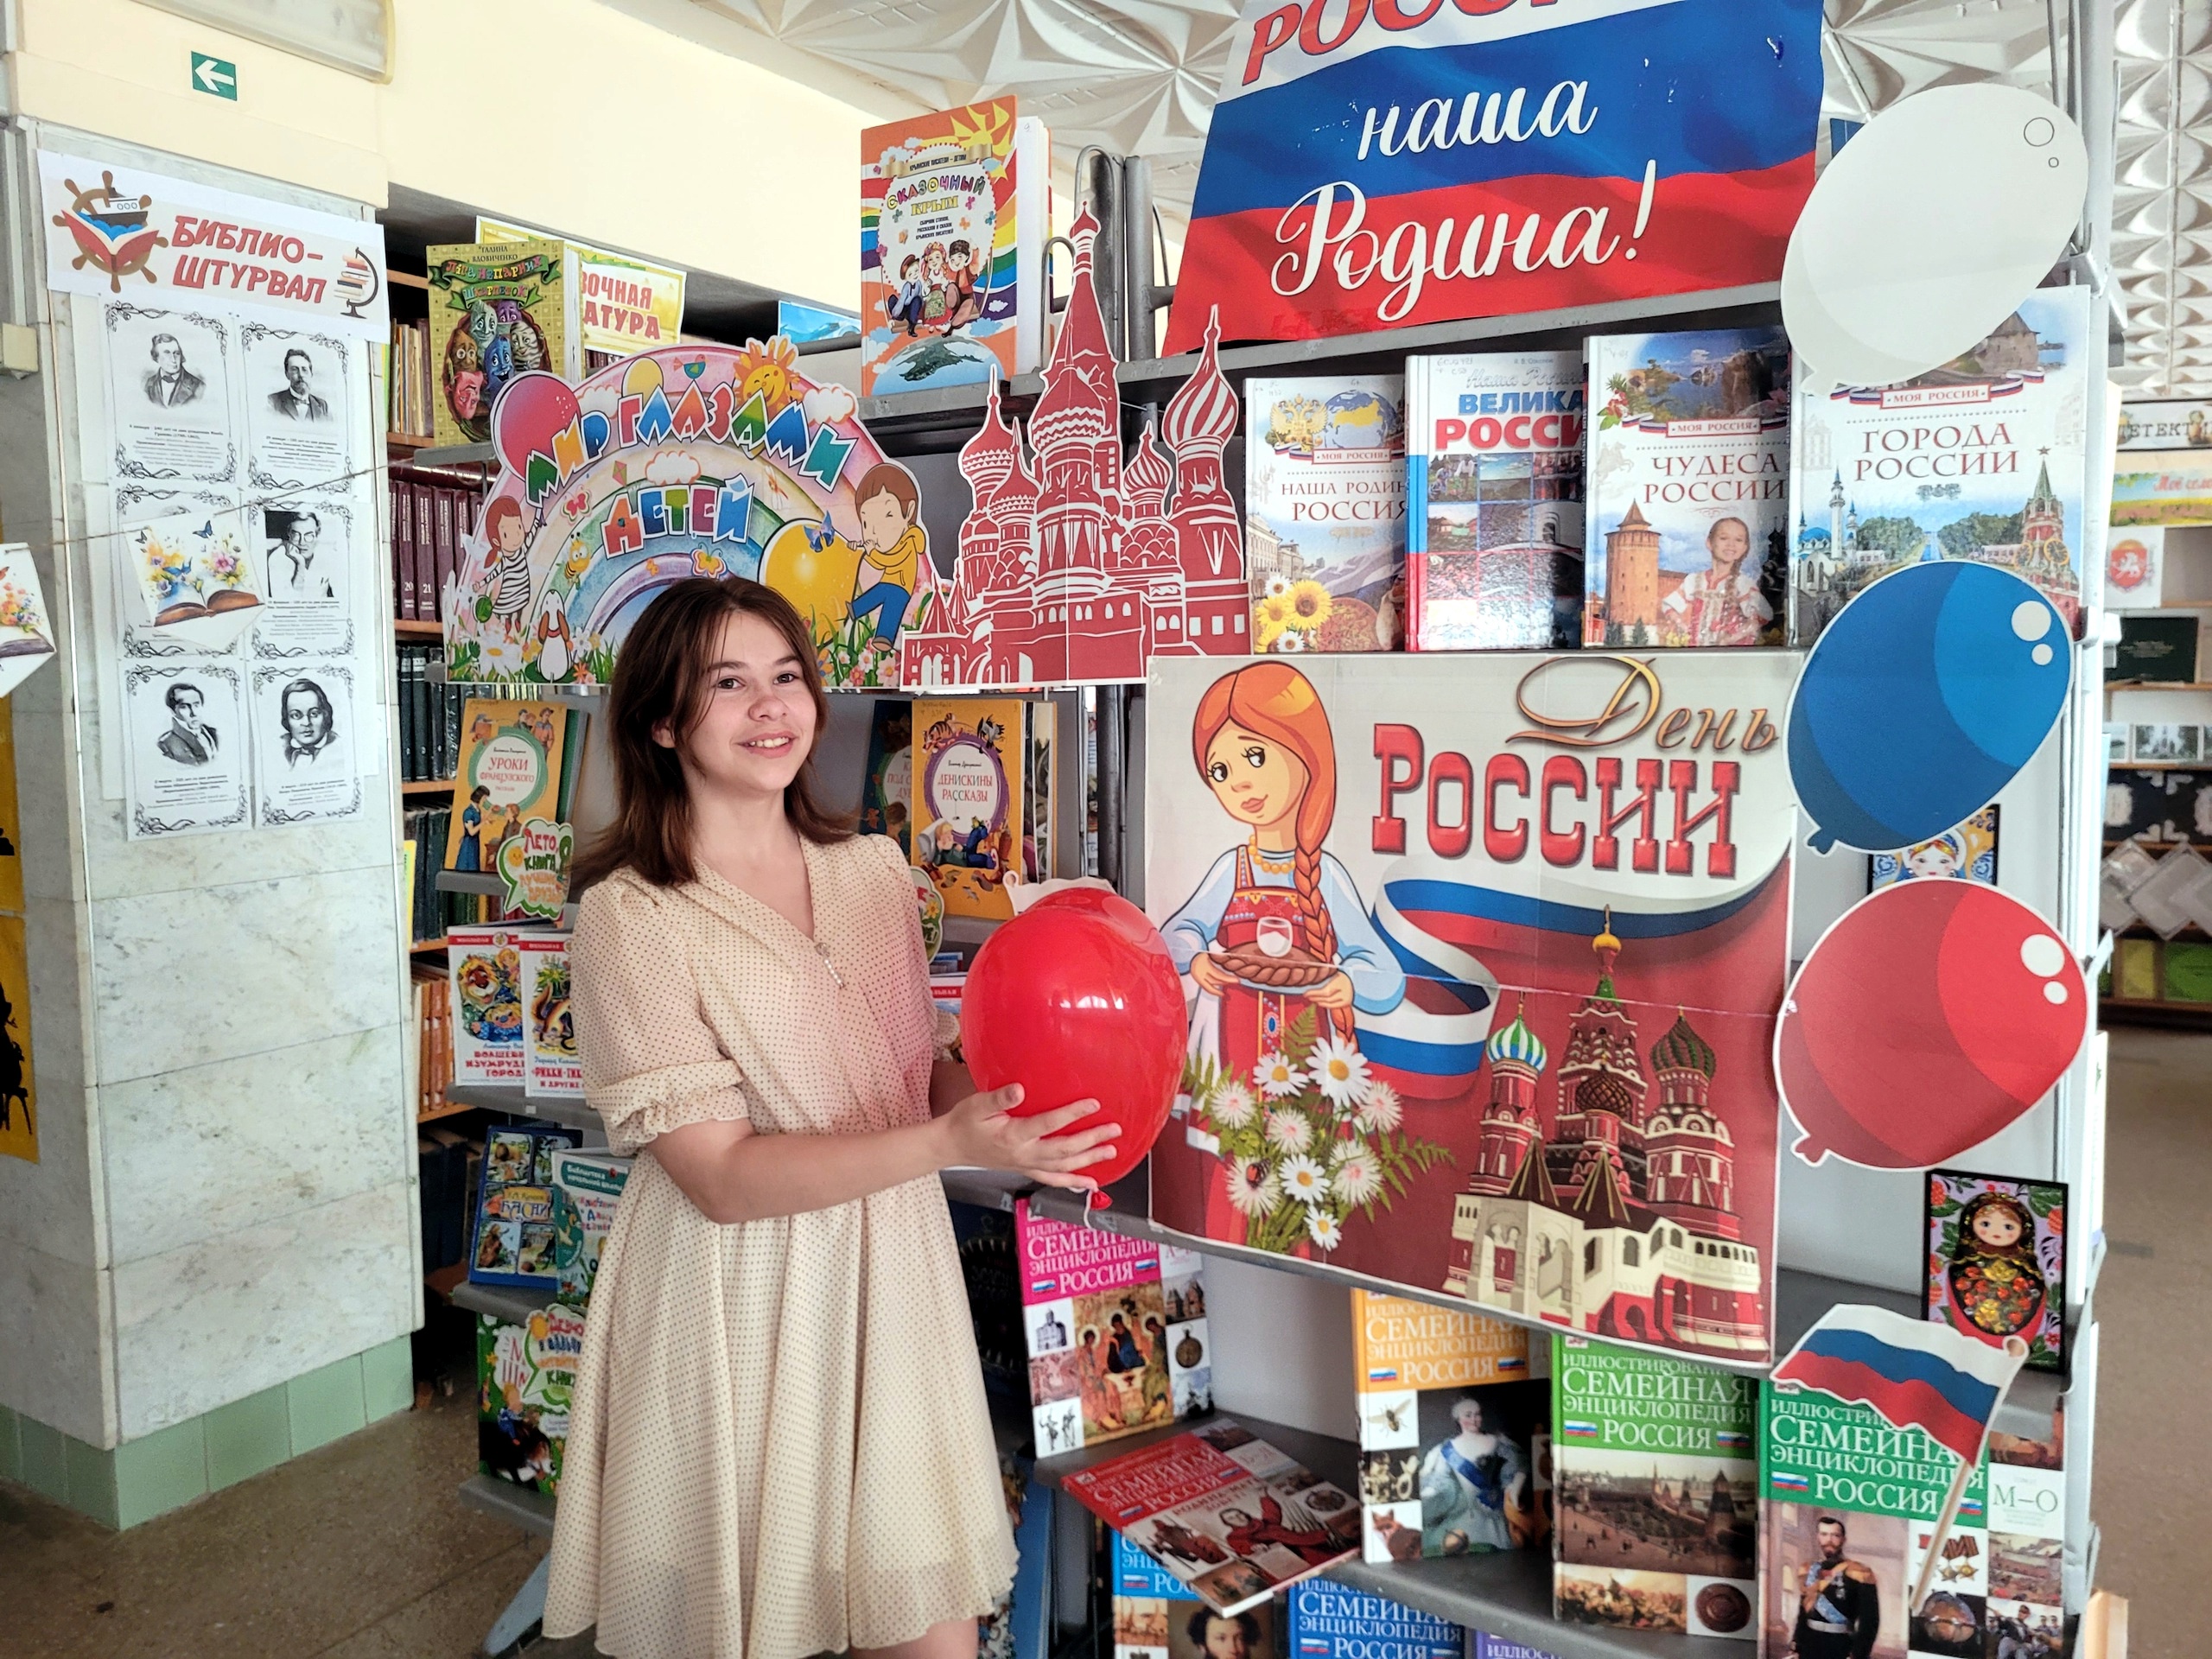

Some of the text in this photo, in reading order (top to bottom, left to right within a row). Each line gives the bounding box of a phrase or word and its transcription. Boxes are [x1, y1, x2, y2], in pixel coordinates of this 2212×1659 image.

[1357, 79, 1598, 161] наша
[887, 175, 986, 210] СКАЗОЧНЫЙ
[911, 195, 959, 216] КРЫМ
[172, 215, 323, 264] БИБЛИО-
[1270, 159, 1656, 321] Родина!
[472, 254, 518, 263] ВДОВИЧЕНКО
[173, 255, 327, 303] ШТУРВАЛ
[1522, 367, 1585, 391] Родин
[1459, 390, 1584, 415] ВЕЛИКА
[1893, 389, 1979, 403] МОЯ РОССИЯ
[1435, 415, 1584, 451] РОССИ
[1707, 422, 1753, 430] РОССИЯ
[1862, 423, 2012, 454] ГОРОДА
[2118, 422, 2212, 438] ЕТЕКТ
[525, 381, 858, 507] МИР ГЛАЗАМИ
[1651, 453, 1781, 477] ЧУДЕСА
[1854, 450, 2019, 482] РОССИИ
[1281, 481, 1406, 495] НАША РОДИН
[1643, 479, 1787, 504] РОССИИ
[601, 473, 754, 560] ДЕТЕЙ
[423, 583, 432, 593] 21
[1504, 655, 1779, 753] День
[480, 772, 535, 784] ФРАНЦУЗСКОГО
[488, 757, 528, 772] УРОКИ
[938, 773, 993, 787] ДЕНИСКИНЫ
[942, 790, 988, 802] РАССКАЗЫ
[1372, 723, 1741, 880] РОССИИ
[1029, 1240, 1158, 1277] ЭНЦИКЛОПЕДИЯ
[1059, 1262, 1135, 1294] РОССИЯ
[1365, 1313, 1527, 1343] СЕМЕЙНА
[1368, 1334, 1527, 1361] ЭНЦИКЛОПЕДИЯ
[1402, 1356, 1494, 1384] РОССИЯ
[1562, 1367, 1751, 1405] СЕМЕЙНАЯ
[1562, 1395, 1752, 1425] ЭНЦИКЛОПЕДИЯ
[1771, 1399, 1892, 1430] ИЛЛЮСТРИ
[1603, 1418, 1712, 1450] РОССИЯ
[1770, 1414, 1986, 1469] СЕМЕЙНА
[1770, 1444, 1985, 1490] ЭНЦИКЛОПЕДЯ
[1143, 1475, 1222, 1511] РОССИЯ
[1815, 1473, 1939, 1515] РОССИЯ
[1298, 1591, 1457, 1624] СЕМЕЙН
[1299, 1616, 1465, 1643] ЭНЦИКЛОПЕДИЯ
[1334, 1637, 1428, 1659] РОССИЯ
